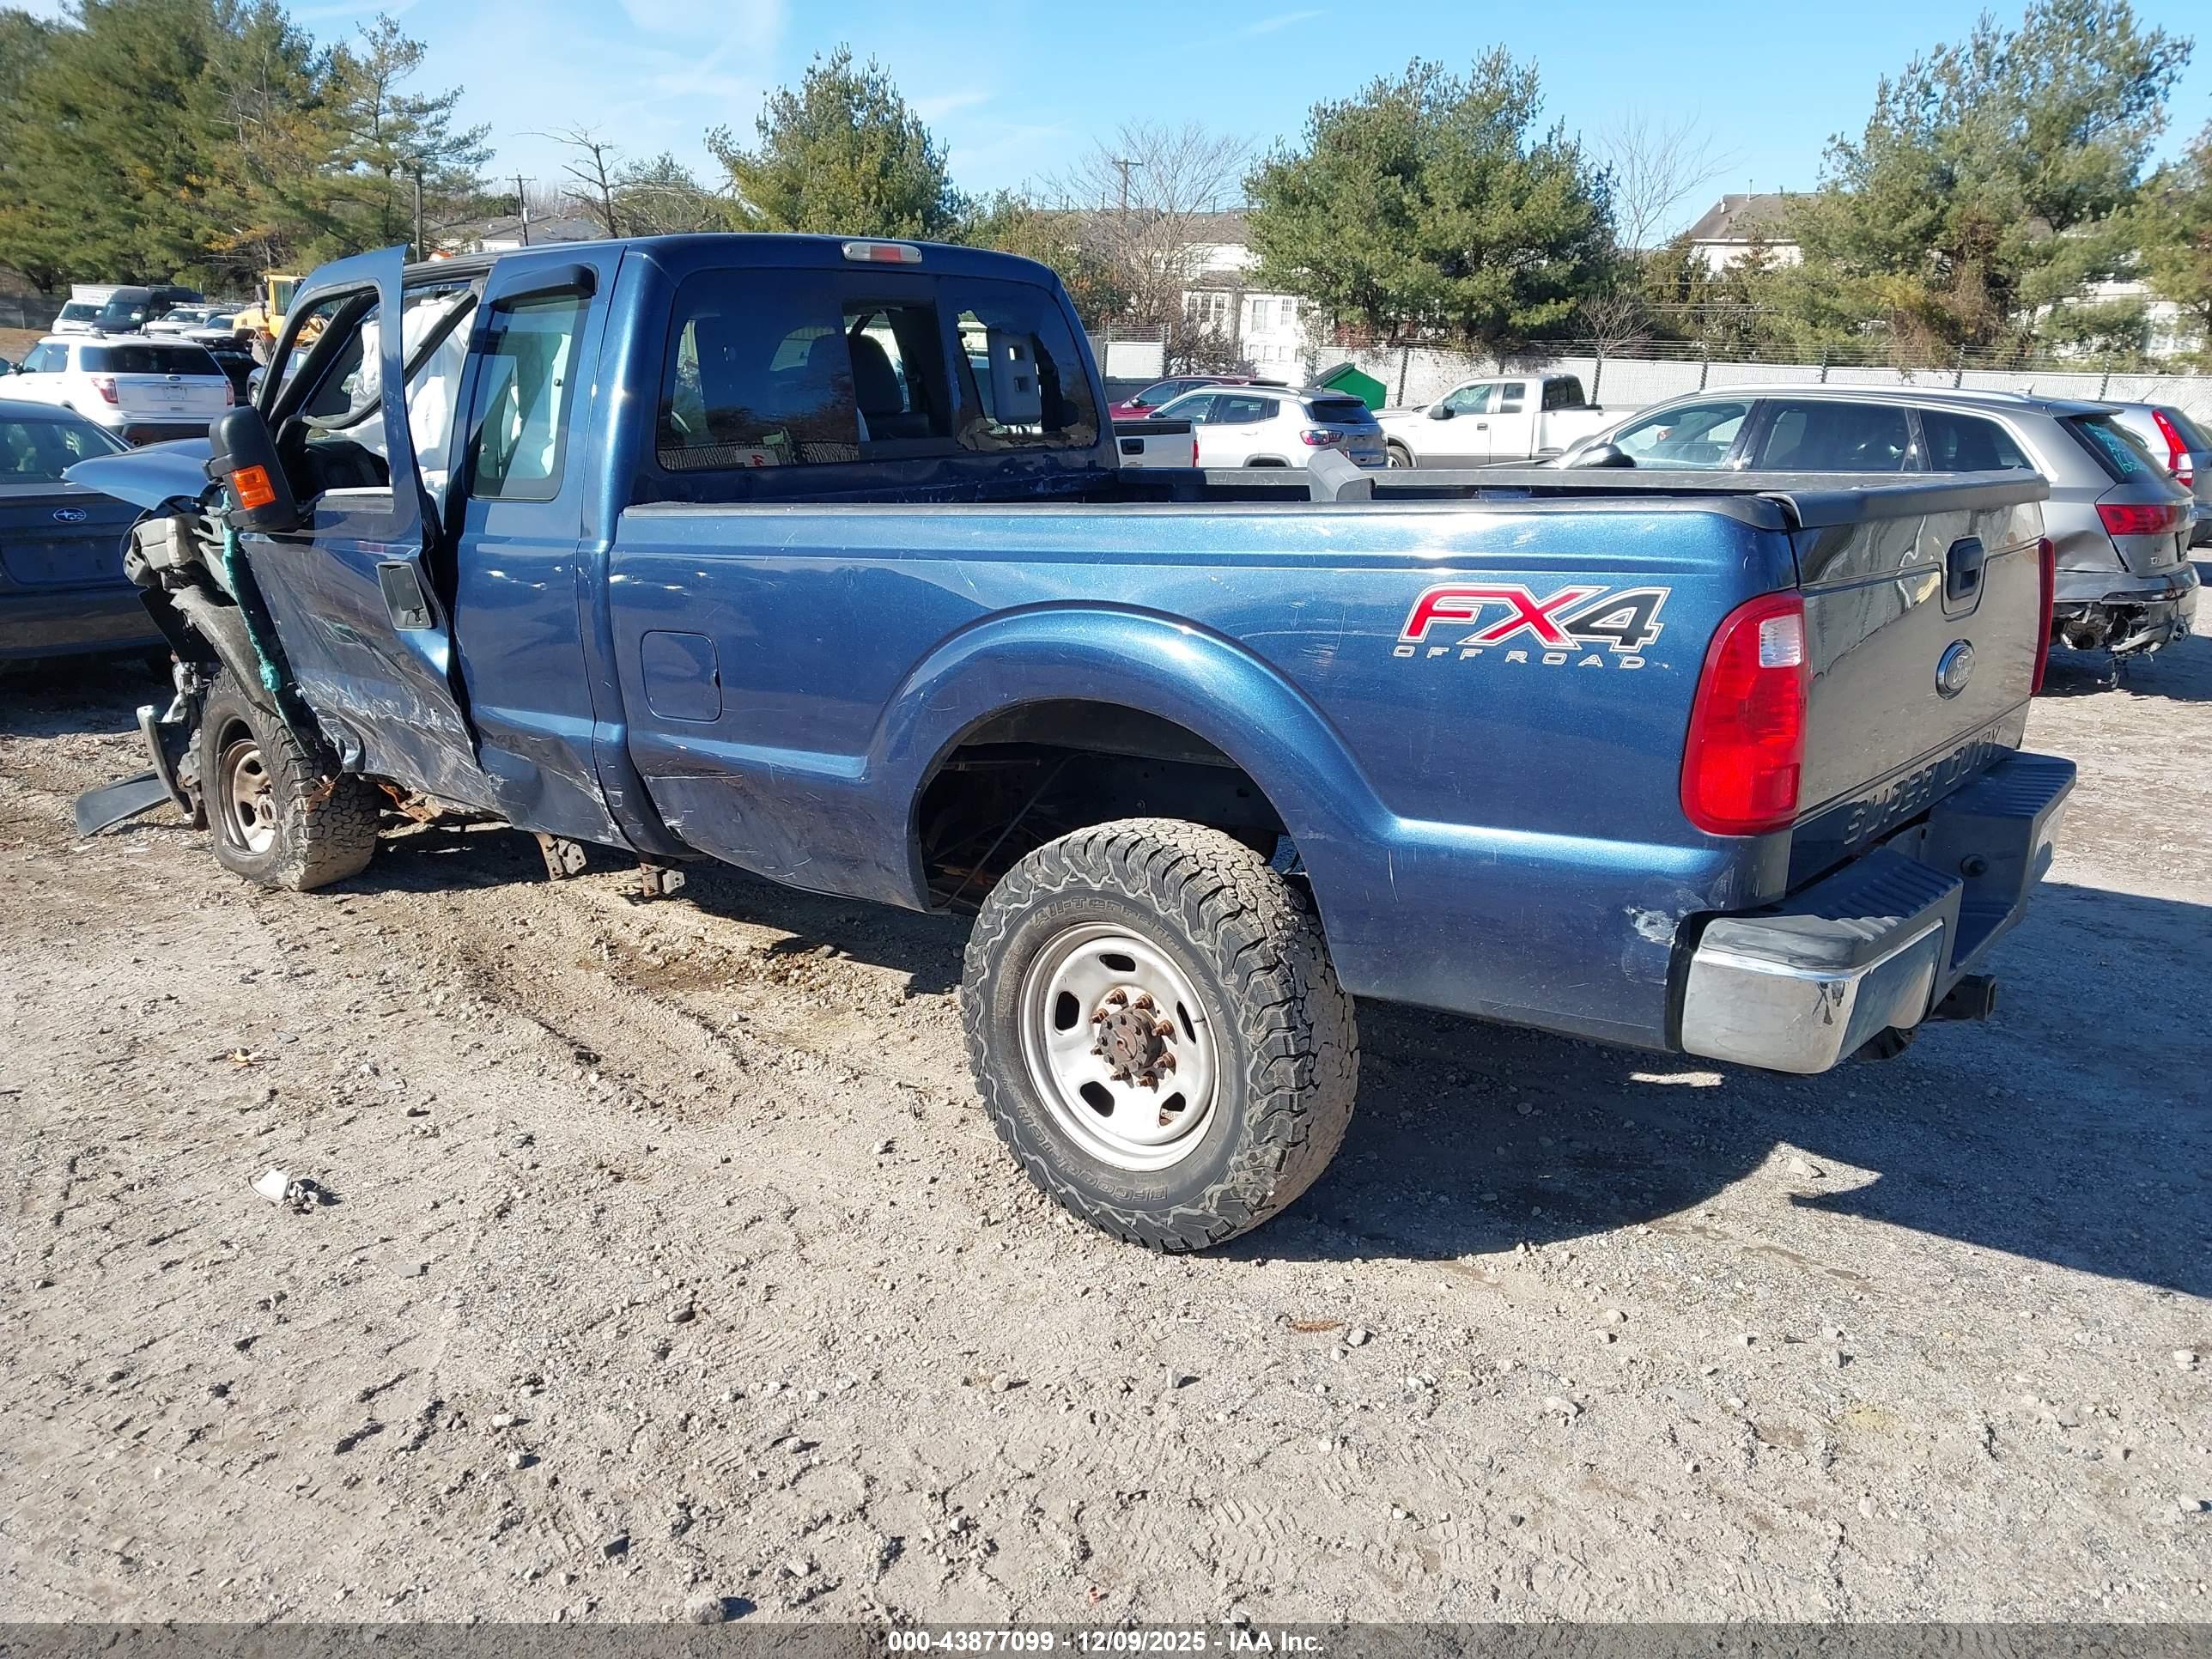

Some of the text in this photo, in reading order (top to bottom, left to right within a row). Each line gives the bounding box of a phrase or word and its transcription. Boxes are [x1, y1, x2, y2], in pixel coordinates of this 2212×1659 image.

[1392, 644, 1647, 670] OFF ROAD
[1397, 582, 1672, 653] FX4
[1844, 725, 2002, 845] SUPER DUTY
[1017, 1105, 1169, 1203] BFGoodrich
